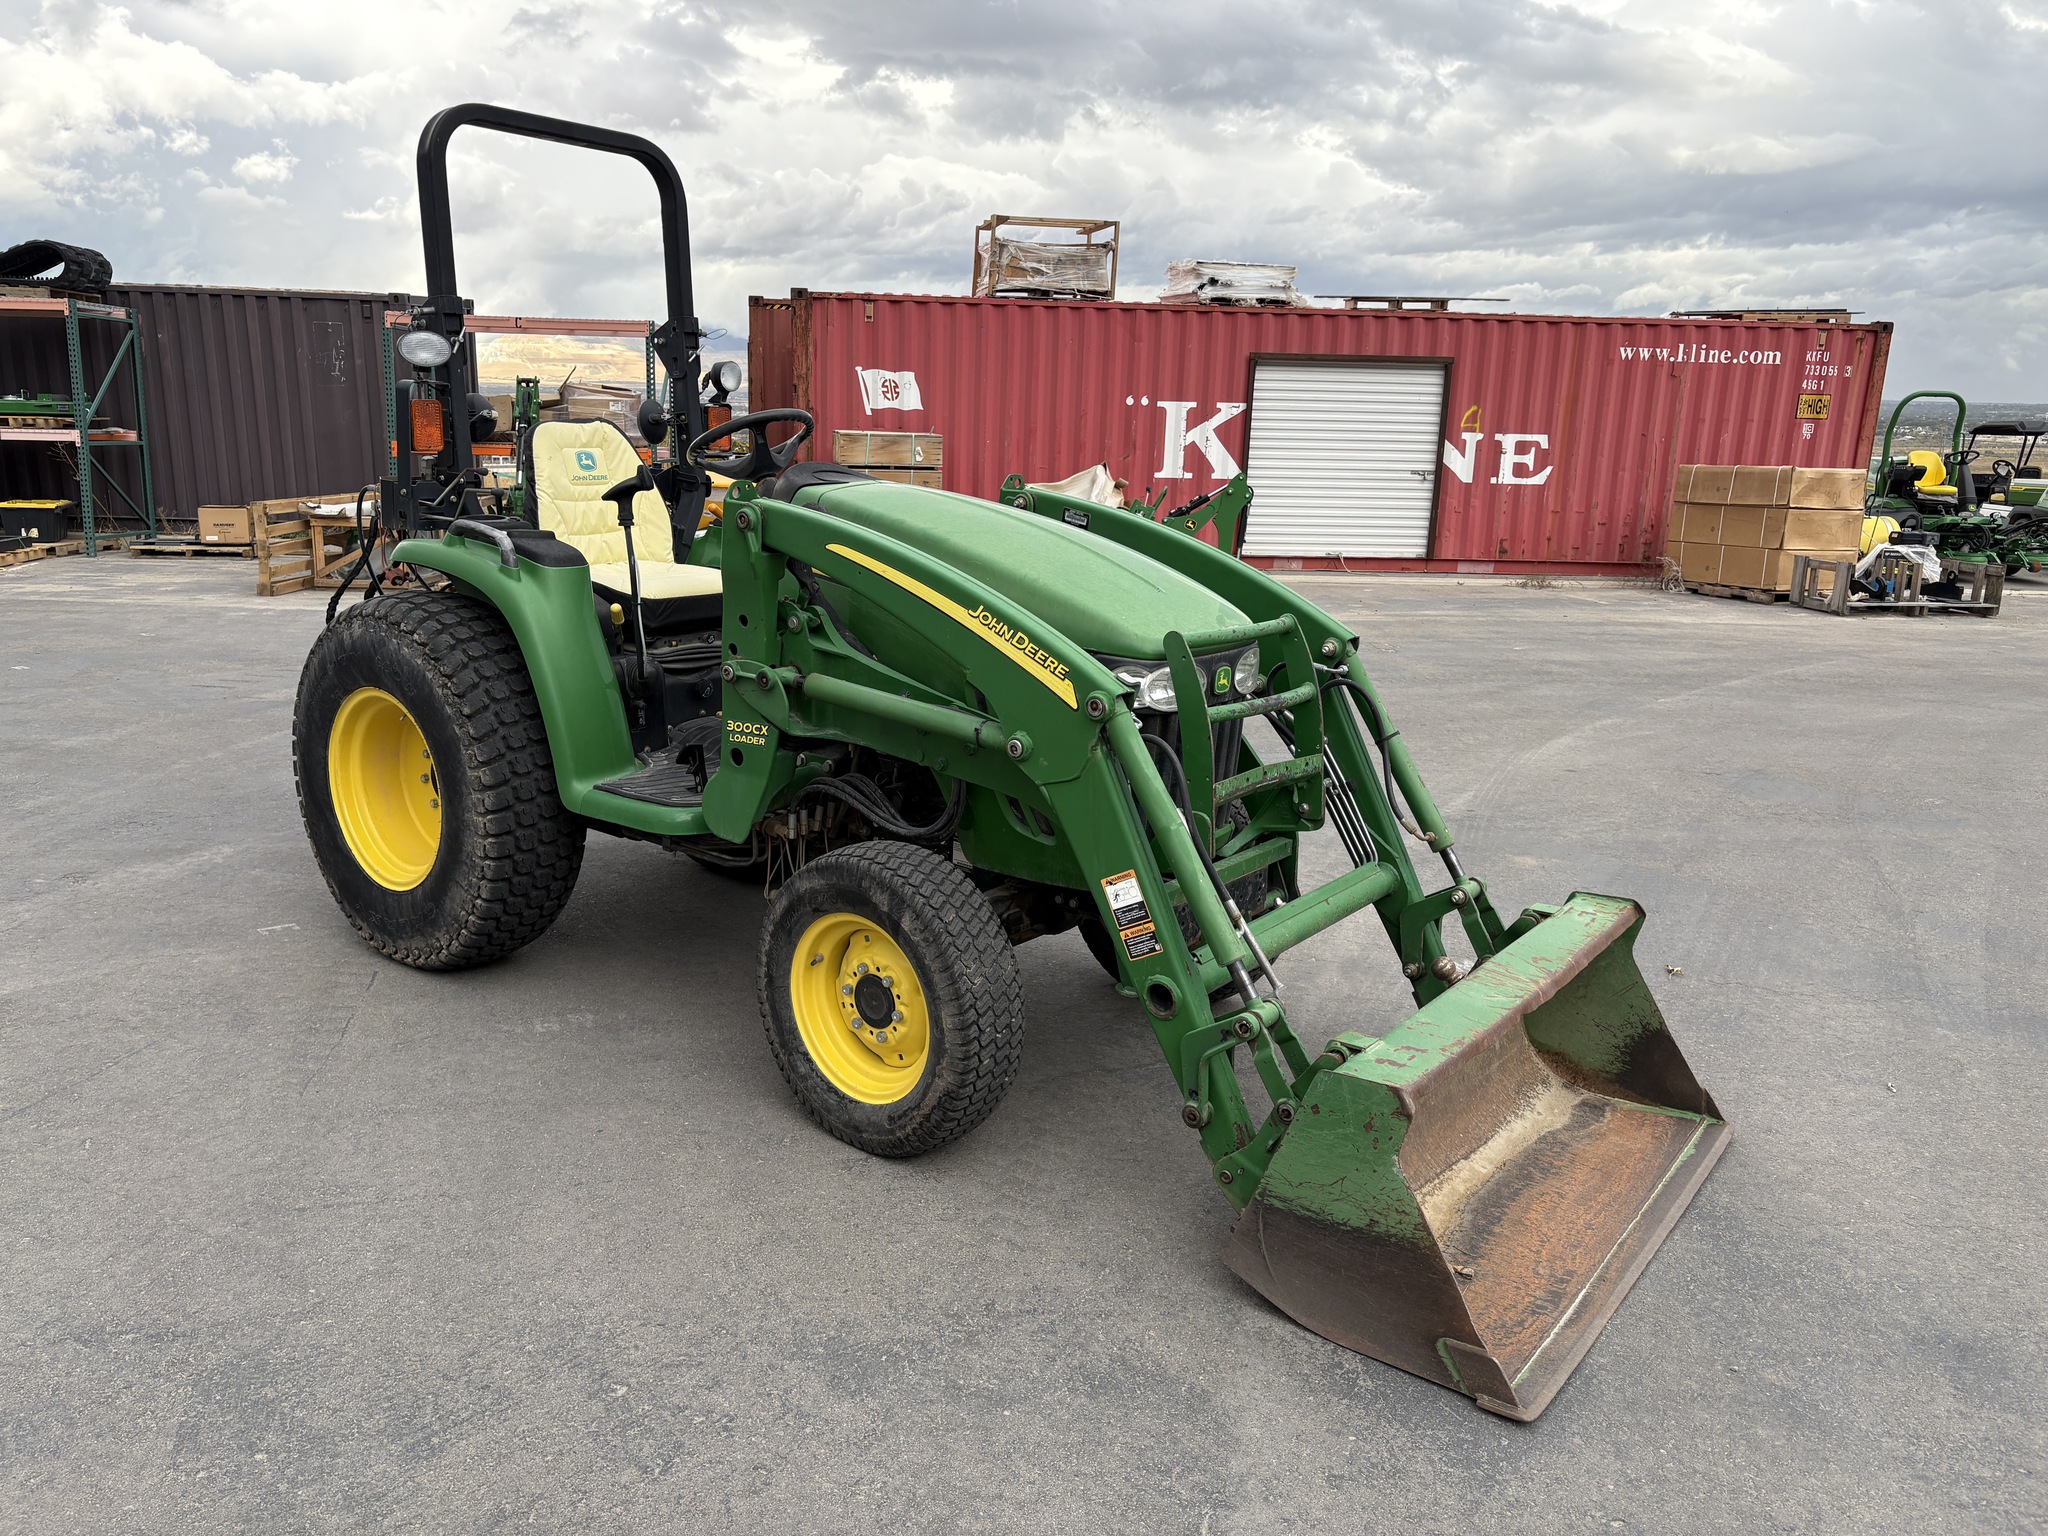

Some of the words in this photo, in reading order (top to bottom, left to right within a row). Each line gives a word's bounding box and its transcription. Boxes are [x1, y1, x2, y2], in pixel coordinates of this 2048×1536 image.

[1619, 343, 1782, 365] www.kline.com
[1805, 351, 1830, 362] KKFU
[1801, 379, 1825, 390] 45G1
[1806, 399, 1830, 415] HIGH
[1461, 405, 1481, 433] 4
[968, 604, 1014, 642] JOHN
[1011, 631, 1070, 680] DEERE
[726, 720, 769, 736] 300CX
[729, 733, 766, 746] LOADER
[1110, 872, 1132, 883] WARNING
[1130, 925, 1152, 936] WARNING
